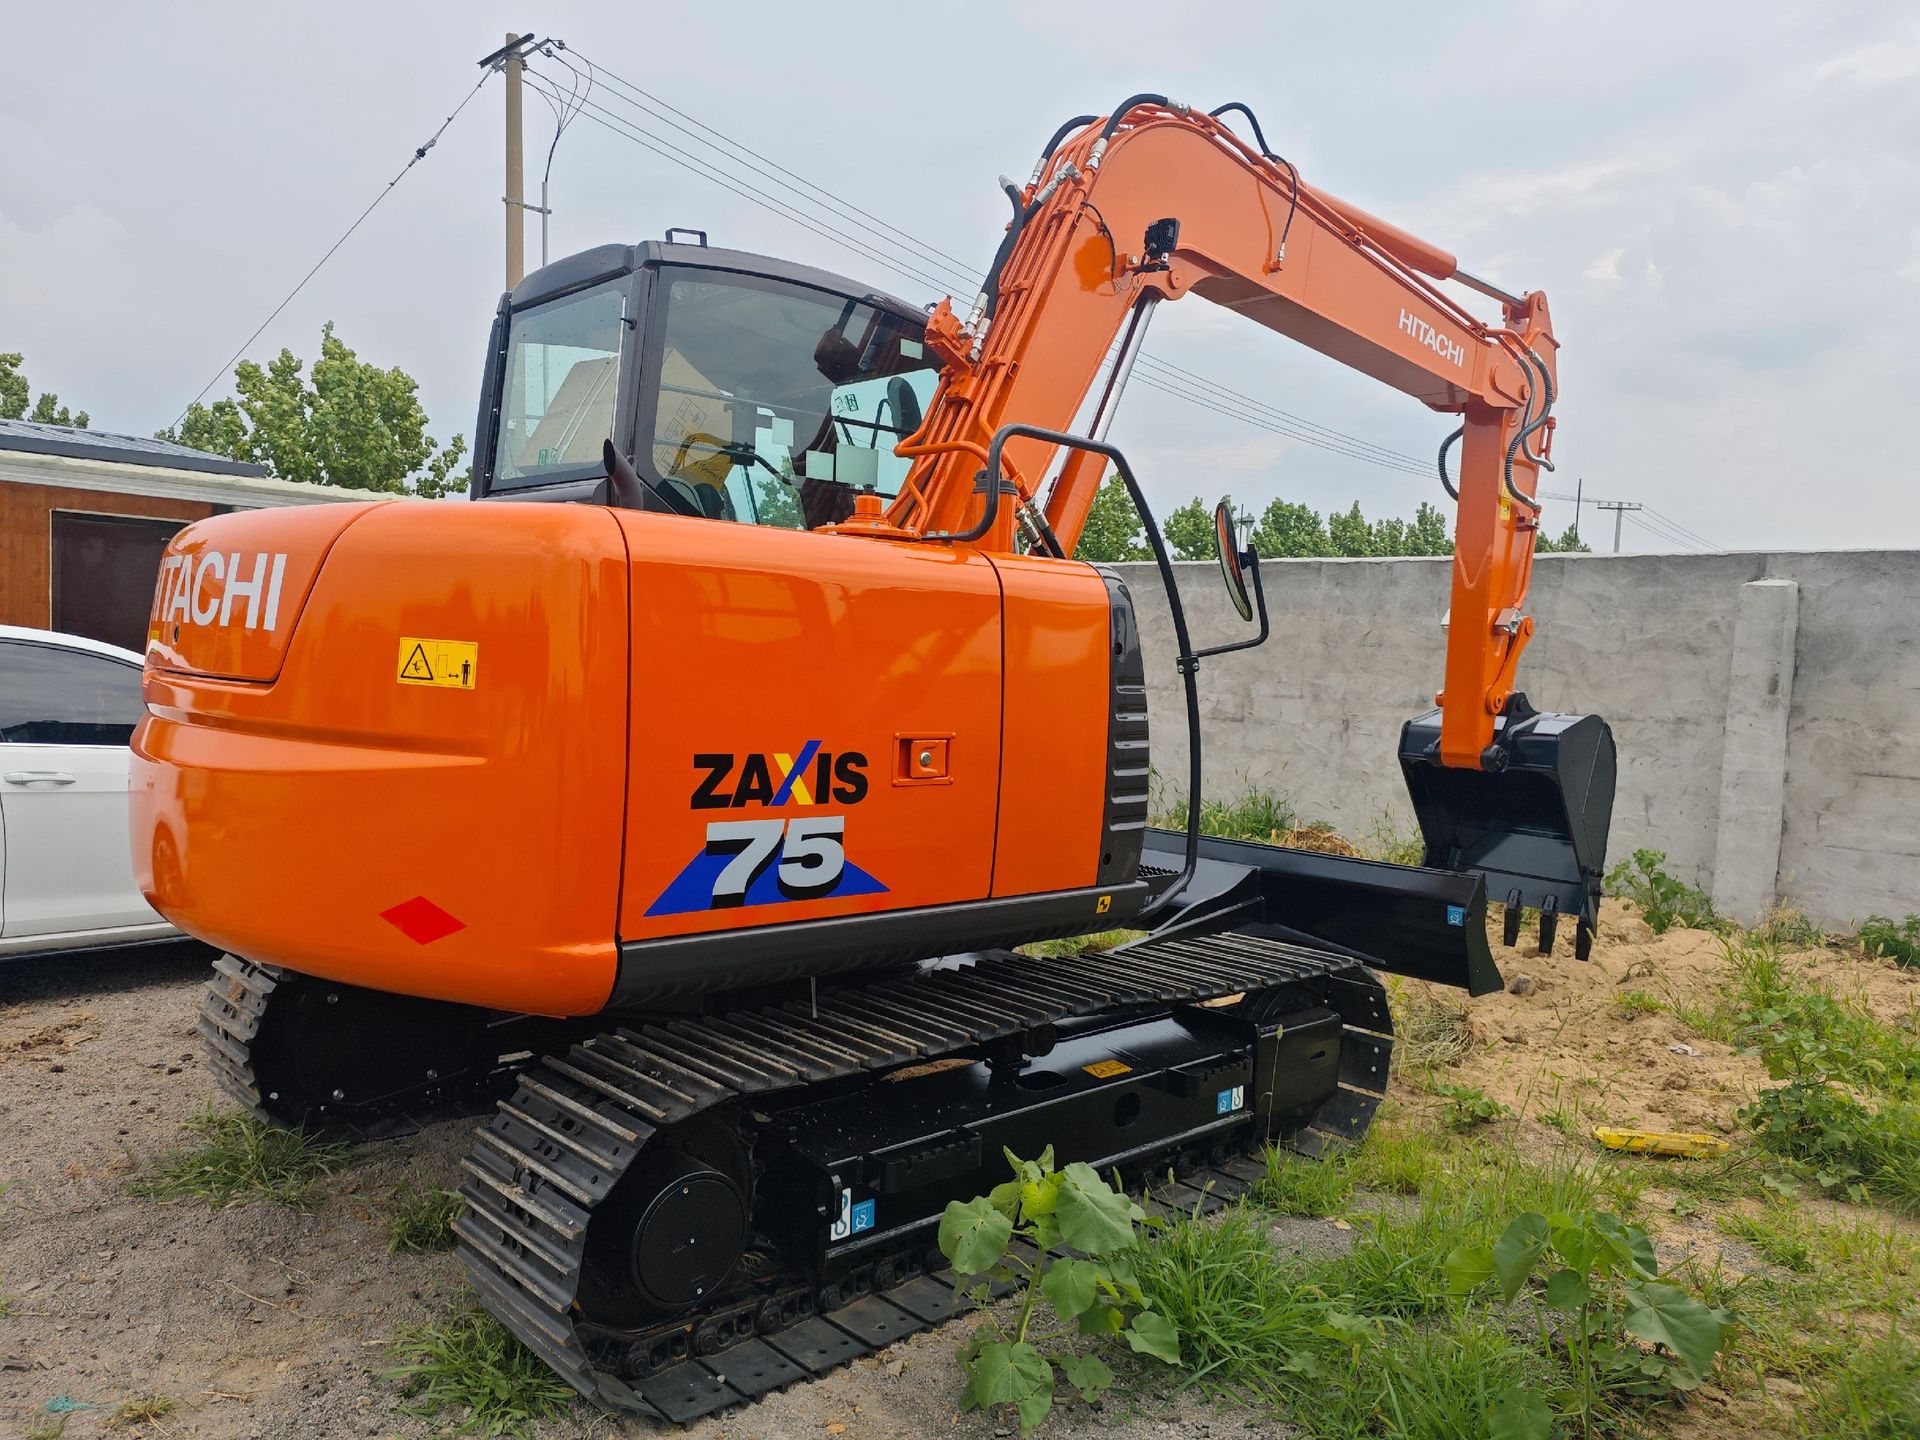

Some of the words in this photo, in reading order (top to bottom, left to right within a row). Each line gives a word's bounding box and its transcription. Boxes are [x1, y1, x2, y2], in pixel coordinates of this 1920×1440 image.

[1398, 307, 1465, 368] HITACHI
[690, 740, 869, 810] ZAXIS
[706, 815, 845, 909] 75
